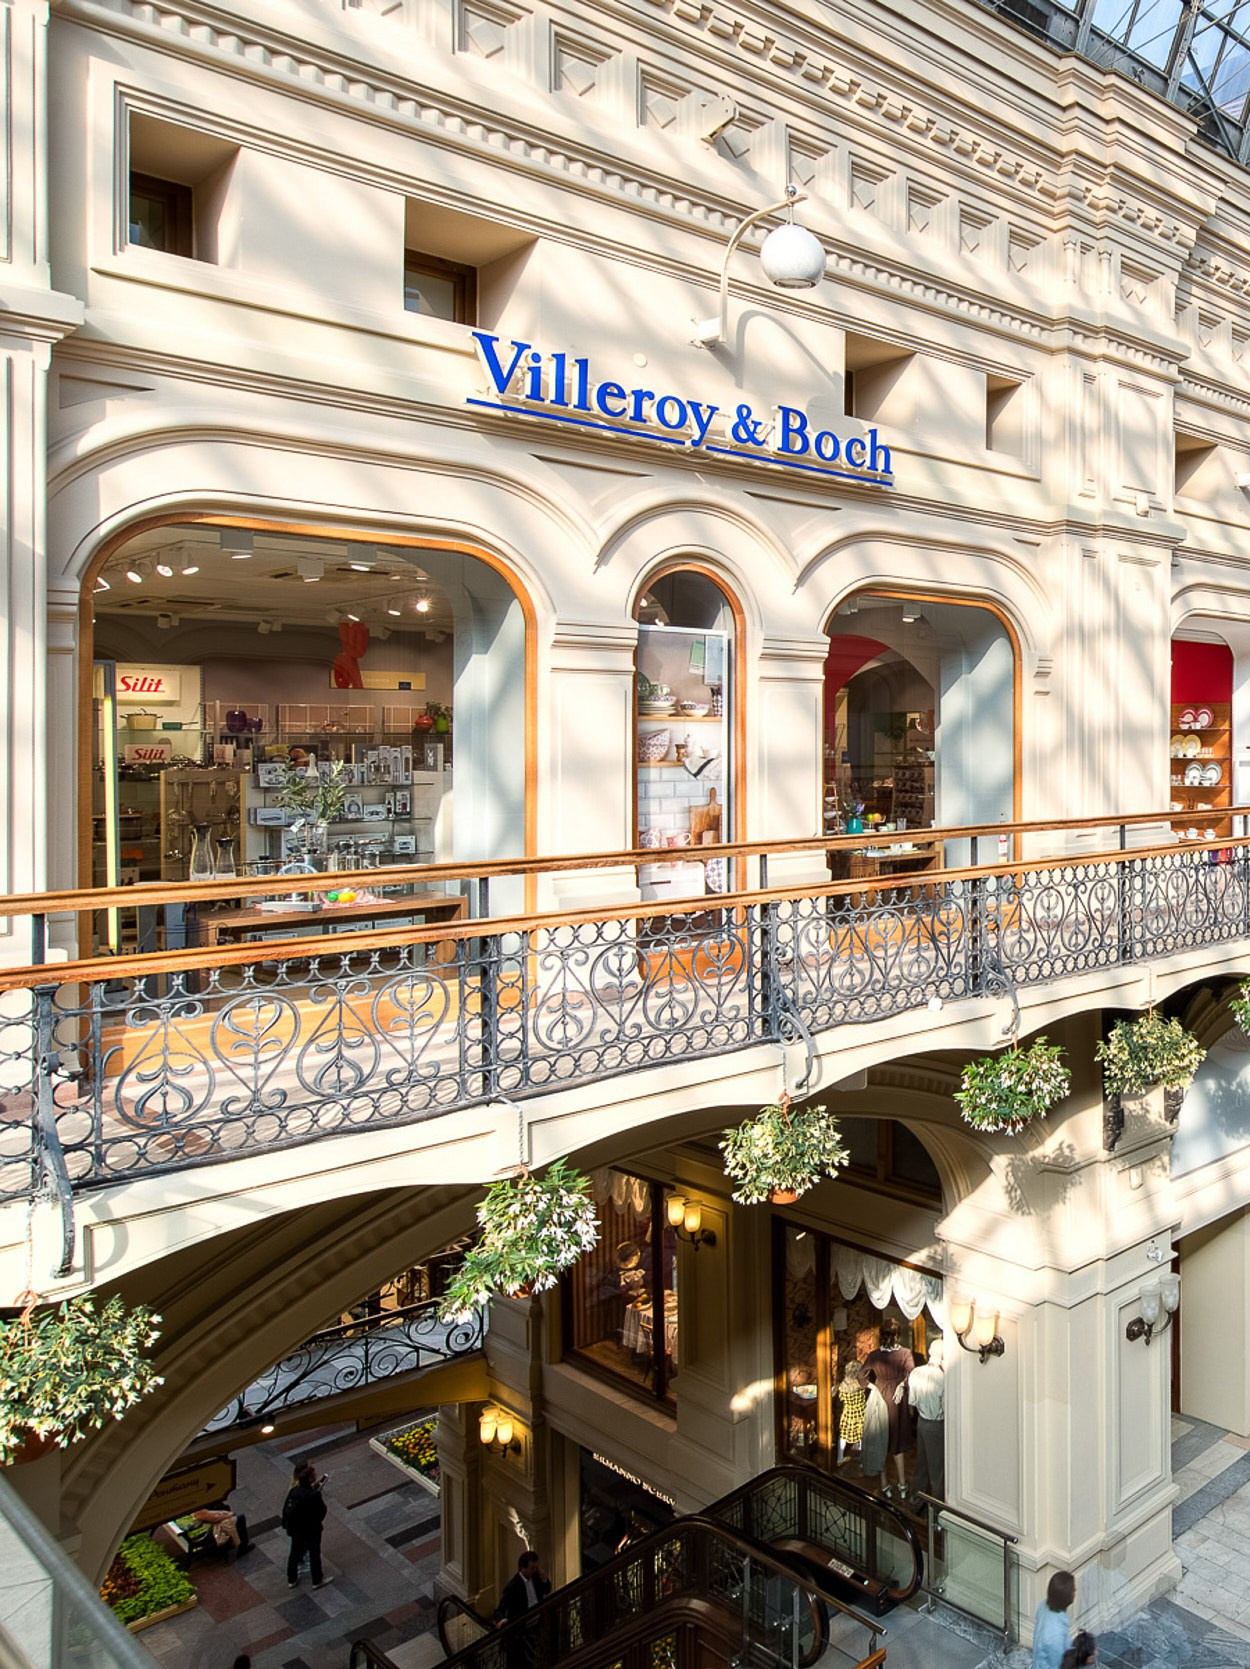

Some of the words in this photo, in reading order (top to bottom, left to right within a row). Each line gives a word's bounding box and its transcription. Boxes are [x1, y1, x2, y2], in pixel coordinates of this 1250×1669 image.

[471, 332, 719, 447] Villeroy
[730, 402, 769, 446] &
[776, 404, 894, 476] Boch
[117, 675, 165, 693] Silit
[133, 747, 166, 761] Silit
[593, 1452, 641, 1485] ERMANNO
